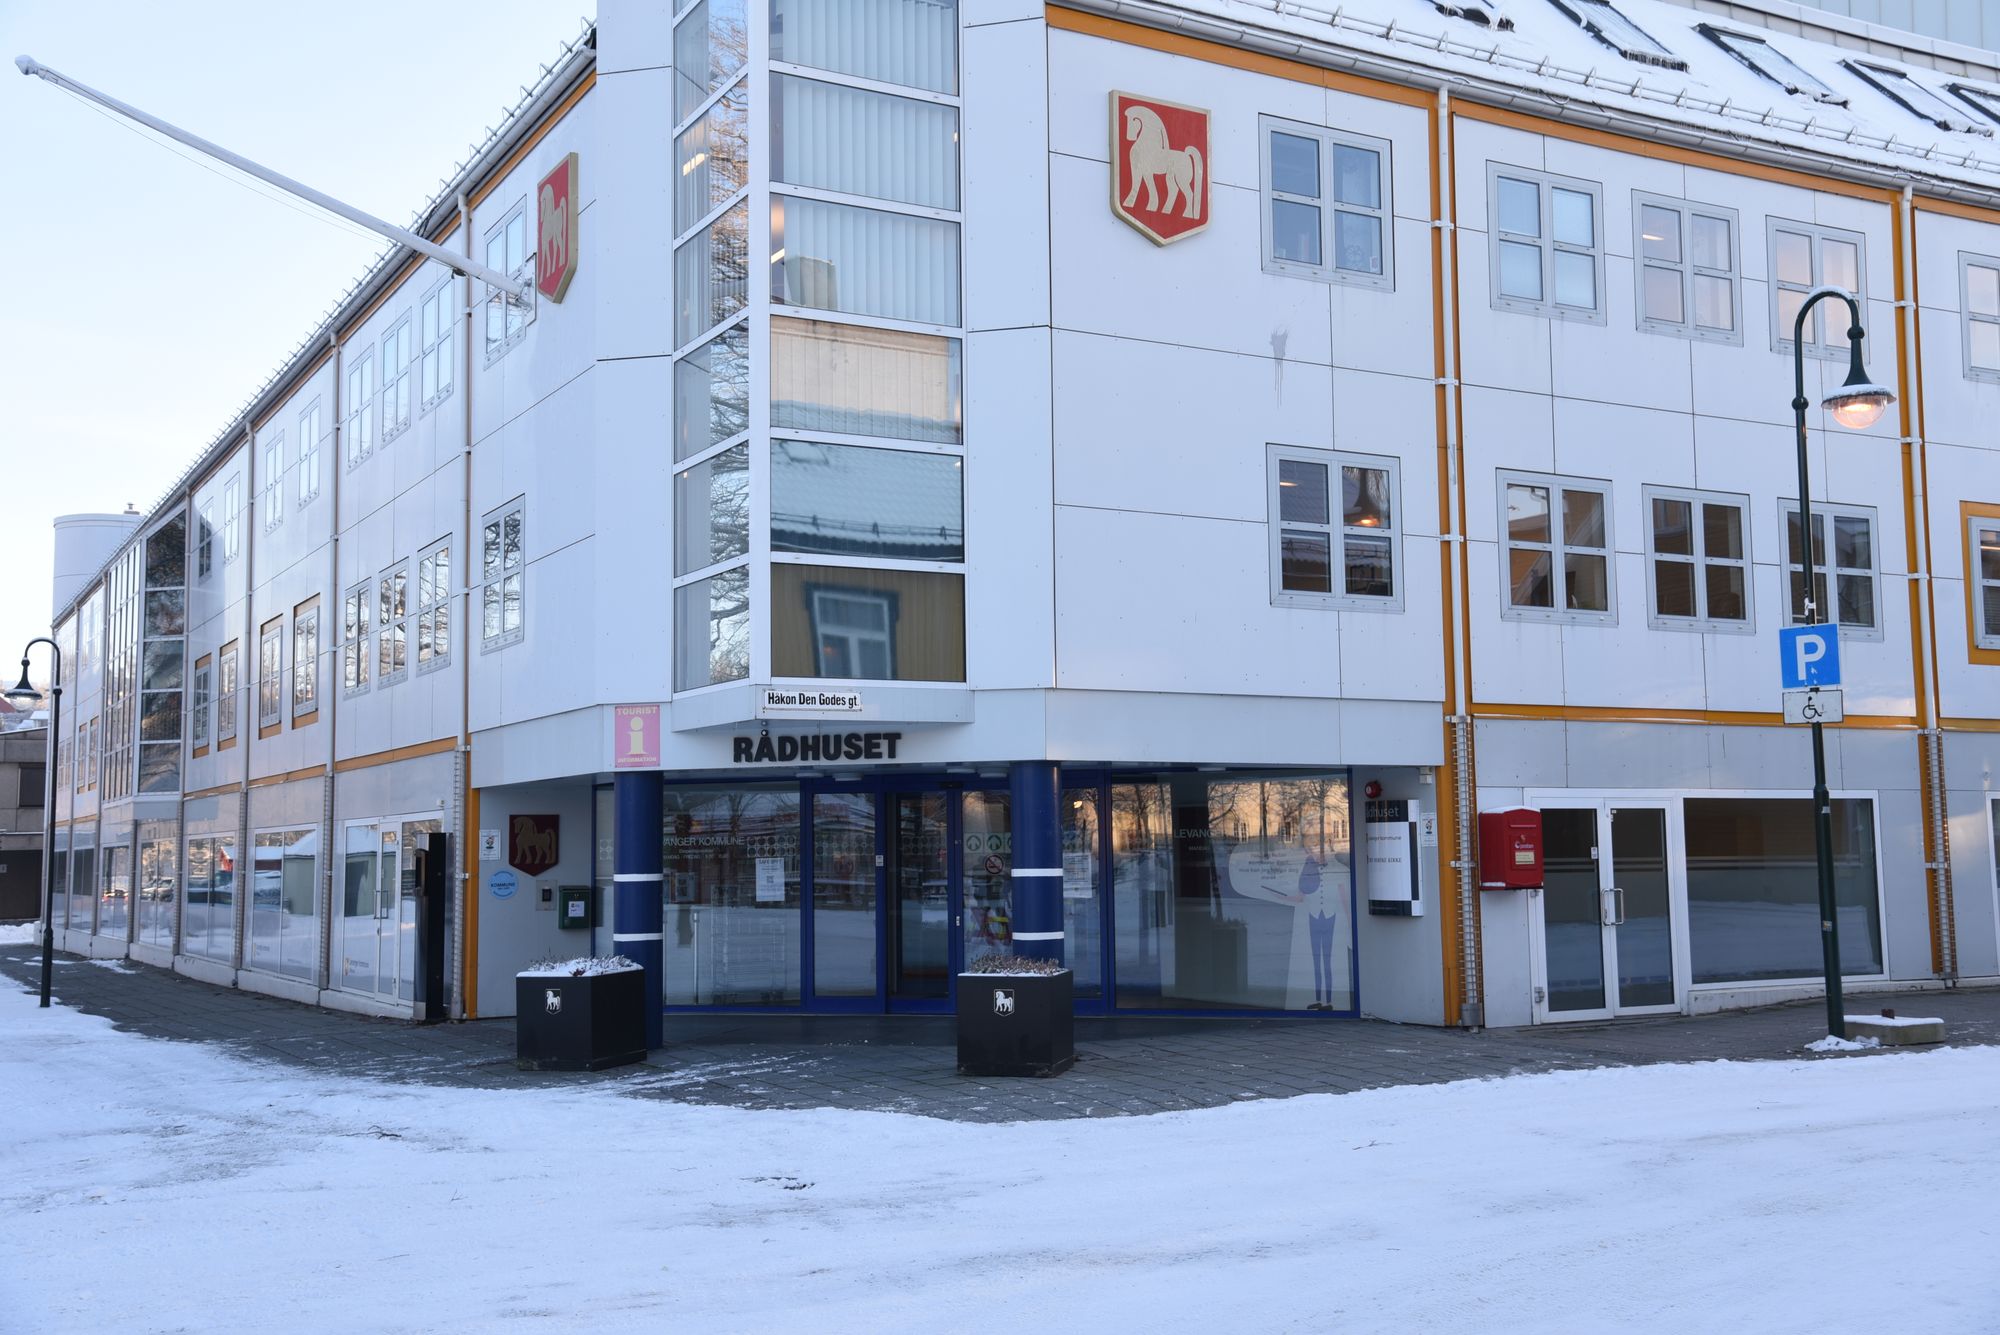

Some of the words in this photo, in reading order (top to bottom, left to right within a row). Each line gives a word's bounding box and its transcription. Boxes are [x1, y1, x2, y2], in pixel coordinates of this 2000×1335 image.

[1796, 634, 1826, 680] P
[767, 692, 796, 705] Håkon
[799, 693, 816, 705] Den
[819, 693, 846, 706] Godes
[848, 695, 860, 709] gt.
[616, 706, 658, 716] TOURIST
[733, 729, 902, 763] RÅDHUSET
[699, 836, 745, 846] KOMMUNE
